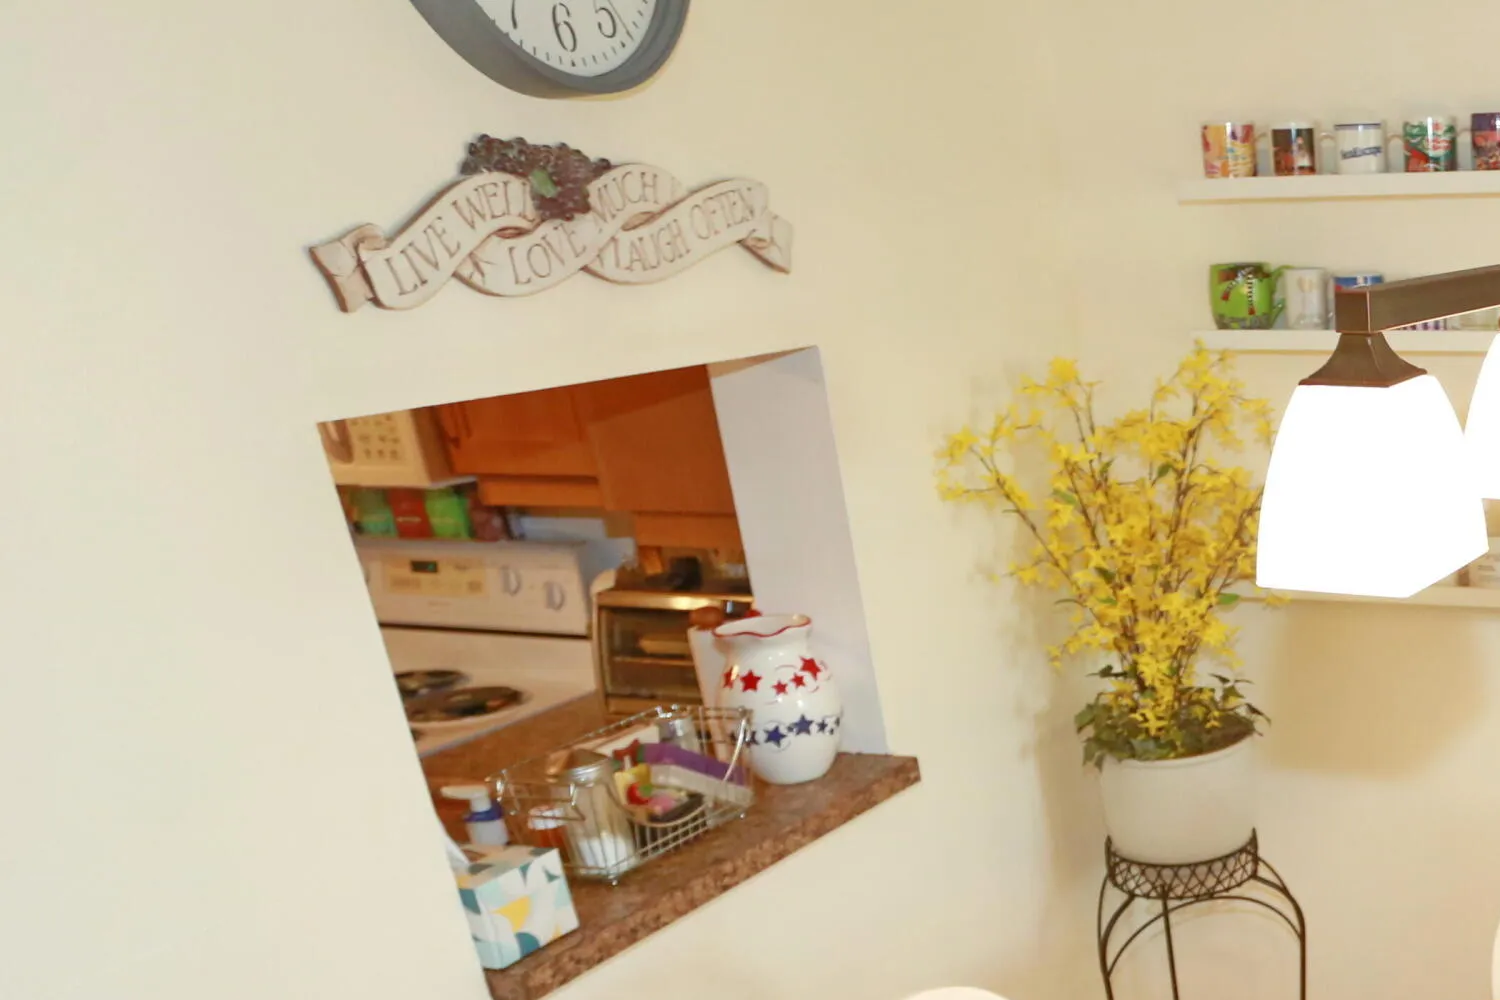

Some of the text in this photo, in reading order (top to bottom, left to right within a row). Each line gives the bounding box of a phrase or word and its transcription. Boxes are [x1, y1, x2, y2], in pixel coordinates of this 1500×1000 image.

[552, 2, 577, 52] 6
[593, 0, 617, 38] 5
[384, 180, 537, 296] LIVE WELL
[508, 171, 659, 285] LOVE MUCH
[613, 187, 758, 271] LAUGH OFTEN
